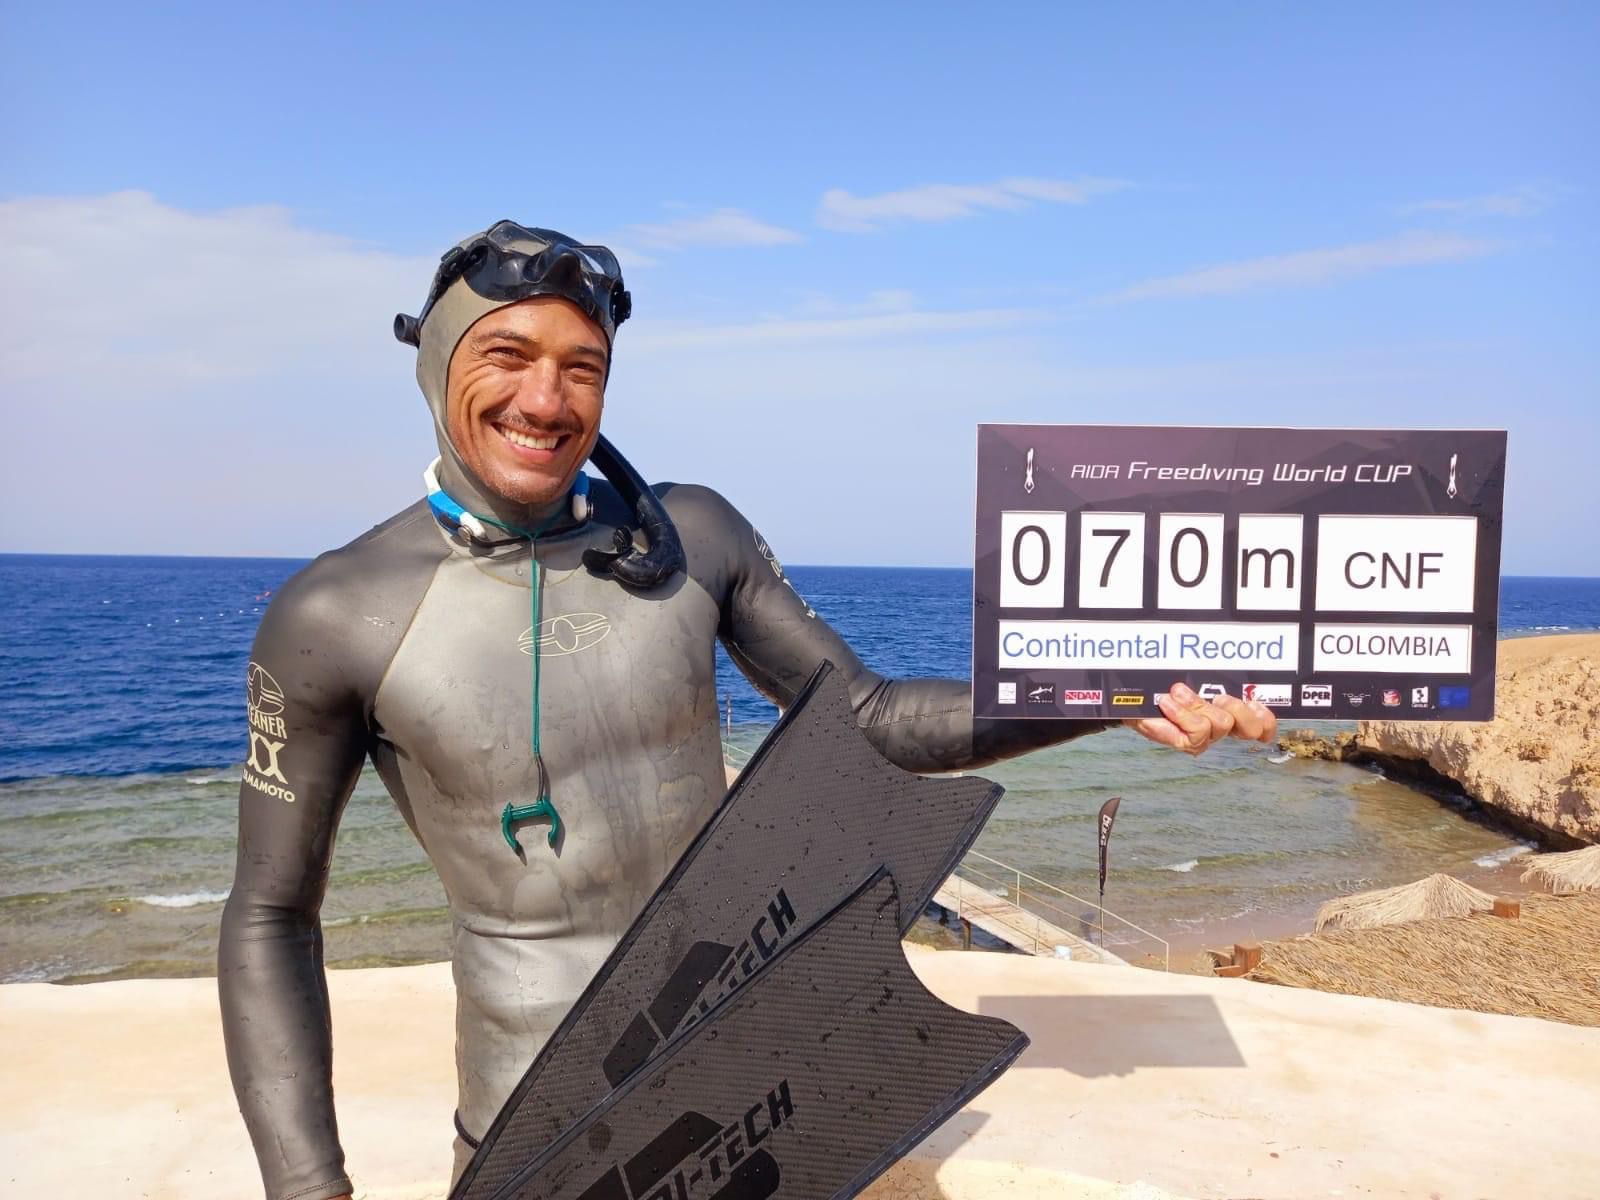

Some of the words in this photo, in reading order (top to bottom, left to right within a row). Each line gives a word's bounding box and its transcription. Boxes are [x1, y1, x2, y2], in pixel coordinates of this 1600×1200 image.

[1070, 464, 1120, 479] AIDA
[1127, 461, 1265, 486] Freediving
[1272, 463, 1348, 482] World
[1354, 464, 1412, 483] CUP
[1344, 551, 1444, 590] CNF
[1002, 631, 1168, 660] Continental
[1179, 633, 1284, 660] Record
[1320, 634, 1451, 657] COLOMBIA
[1077, 691, 1101, 701] DAN
